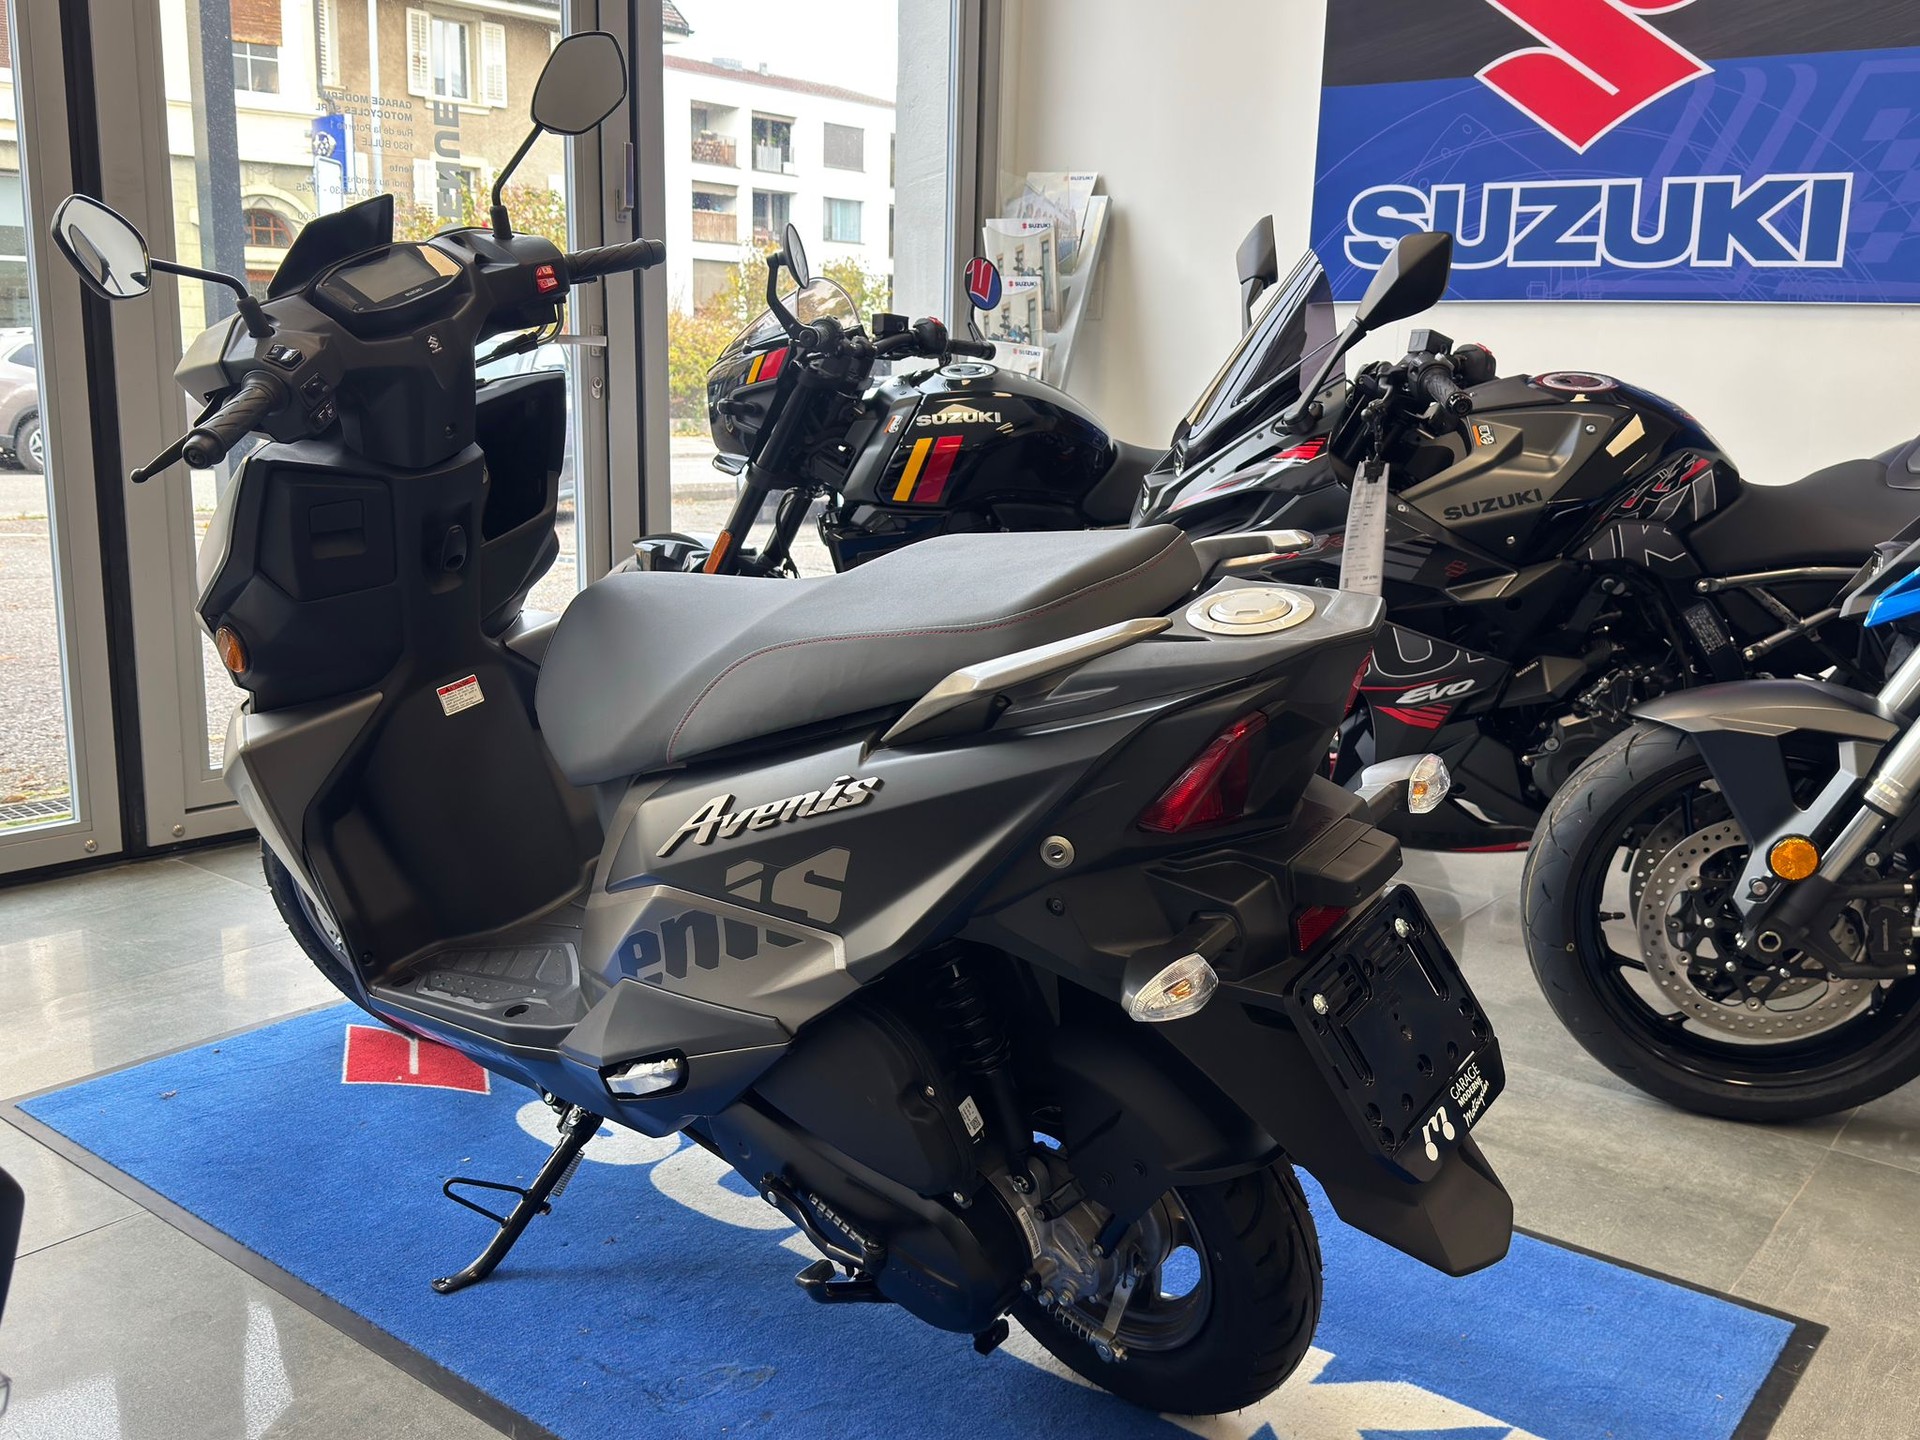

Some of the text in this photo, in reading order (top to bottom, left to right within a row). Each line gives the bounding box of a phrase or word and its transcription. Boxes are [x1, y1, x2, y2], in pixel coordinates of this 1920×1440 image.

[1343, 172, 1854, 270] SUZUKI
[916, 411, 1001, 427] SUZUKI
[1443, 488, 1543, 520] SUZUKI
[656, 774, 885, 857] Avenis
[1450, 1062, 1481, 1100] GARAGE
[1457, 1075, 1484, 1108] MODERNE
